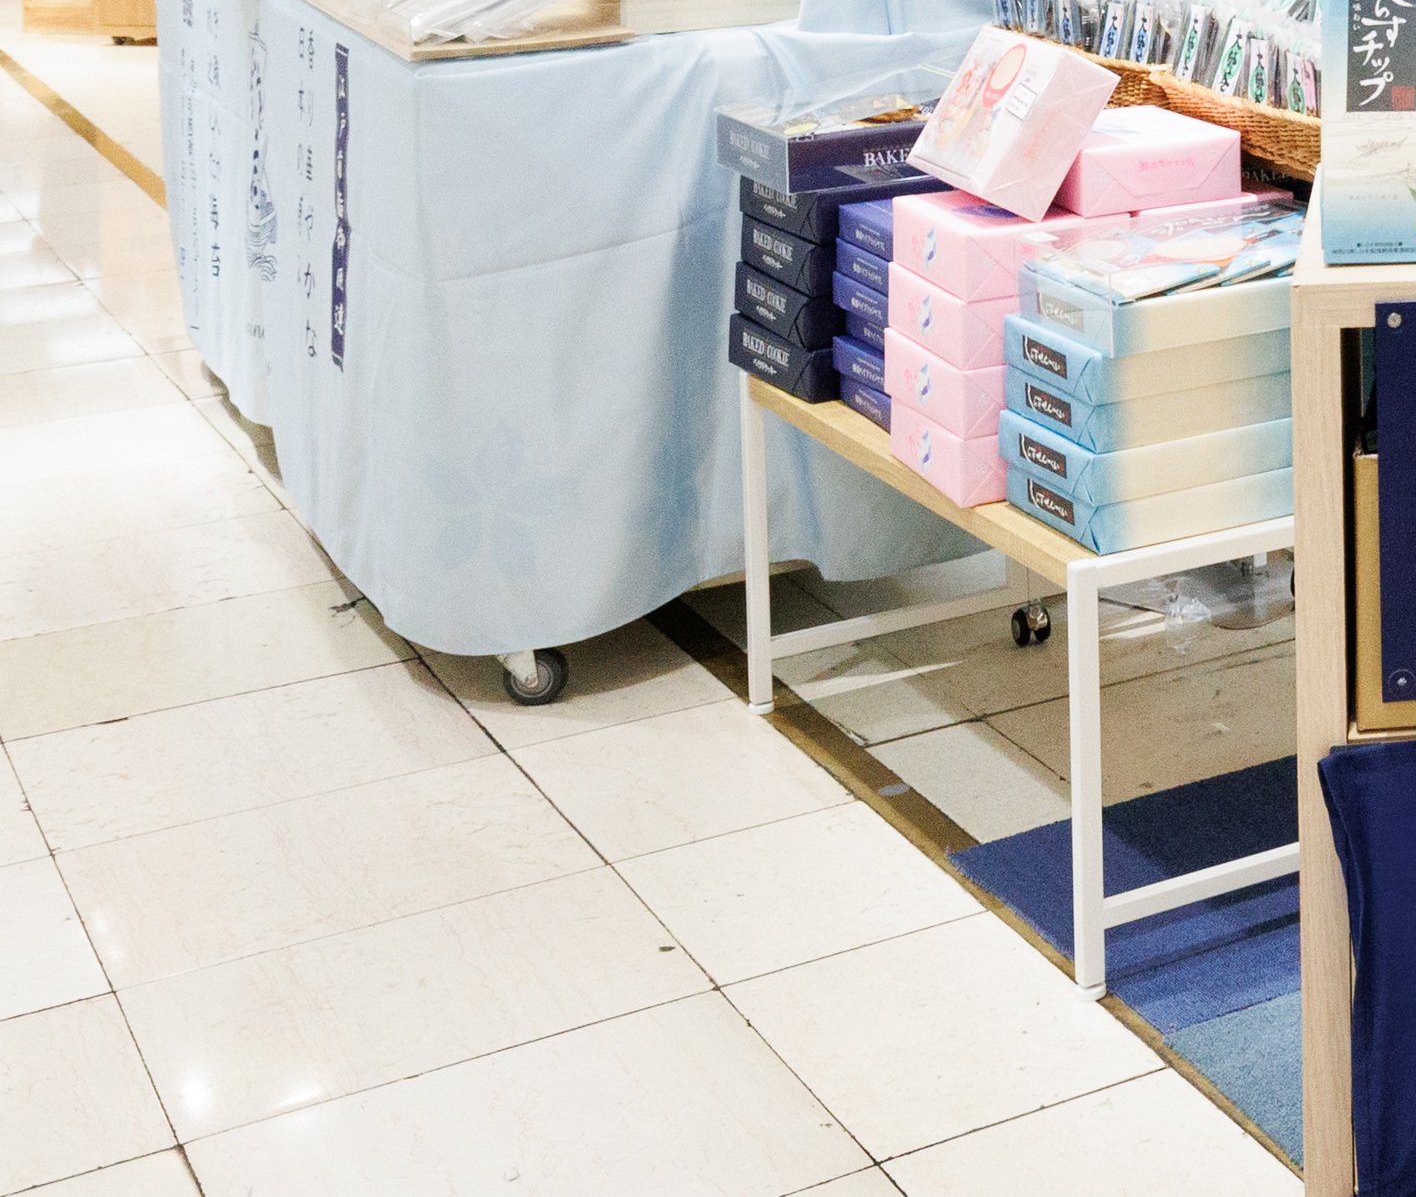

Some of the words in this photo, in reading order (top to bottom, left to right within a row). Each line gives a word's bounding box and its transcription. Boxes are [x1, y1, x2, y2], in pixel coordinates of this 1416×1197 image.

[864, 147, 910, 168] BAKE
[753, 228, 772, 252] BAKED
[746, 278, 766, 300] BAKED
[742, 331, 765, 356] BAKED
